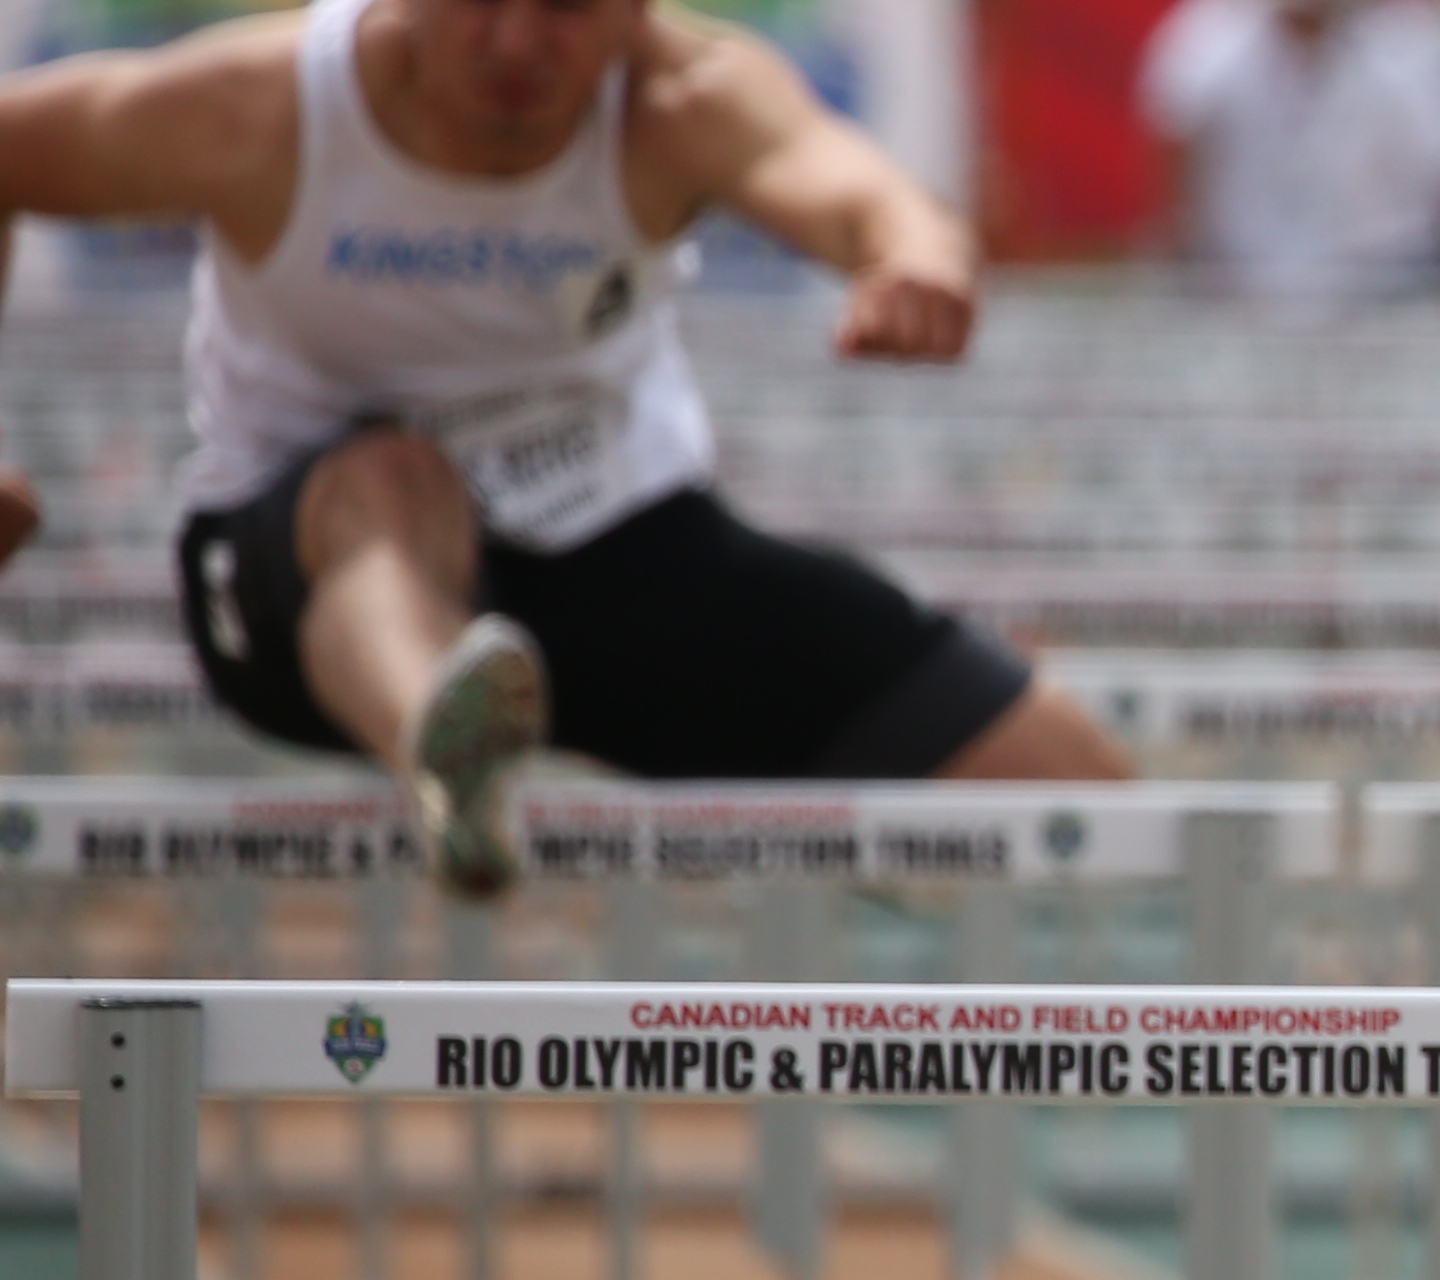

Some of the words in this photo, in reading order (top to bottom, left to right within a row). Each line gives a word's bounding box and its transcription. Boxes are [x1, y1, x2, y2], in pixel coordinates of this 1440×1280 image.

[630, 1003, 811, 1029] CANADIAN
[825, 1004, 938, 1031] TRACK
[950, 1006, 1021, 1032] AND
[1032, 1006, 1129, 1033] FIELD
[1139, 1007, 1401, 1035] CHAMPIONSHIP
[436, 1036, 523, 1091] RIO
[537, 1037, 755, 1095] OLYMPIC
[769, 1047, 804, 1095] &
[818, 1040, 1130, 1097] PARALYMPIC
[1145, 1042, 1406, 1098] SELECTION
